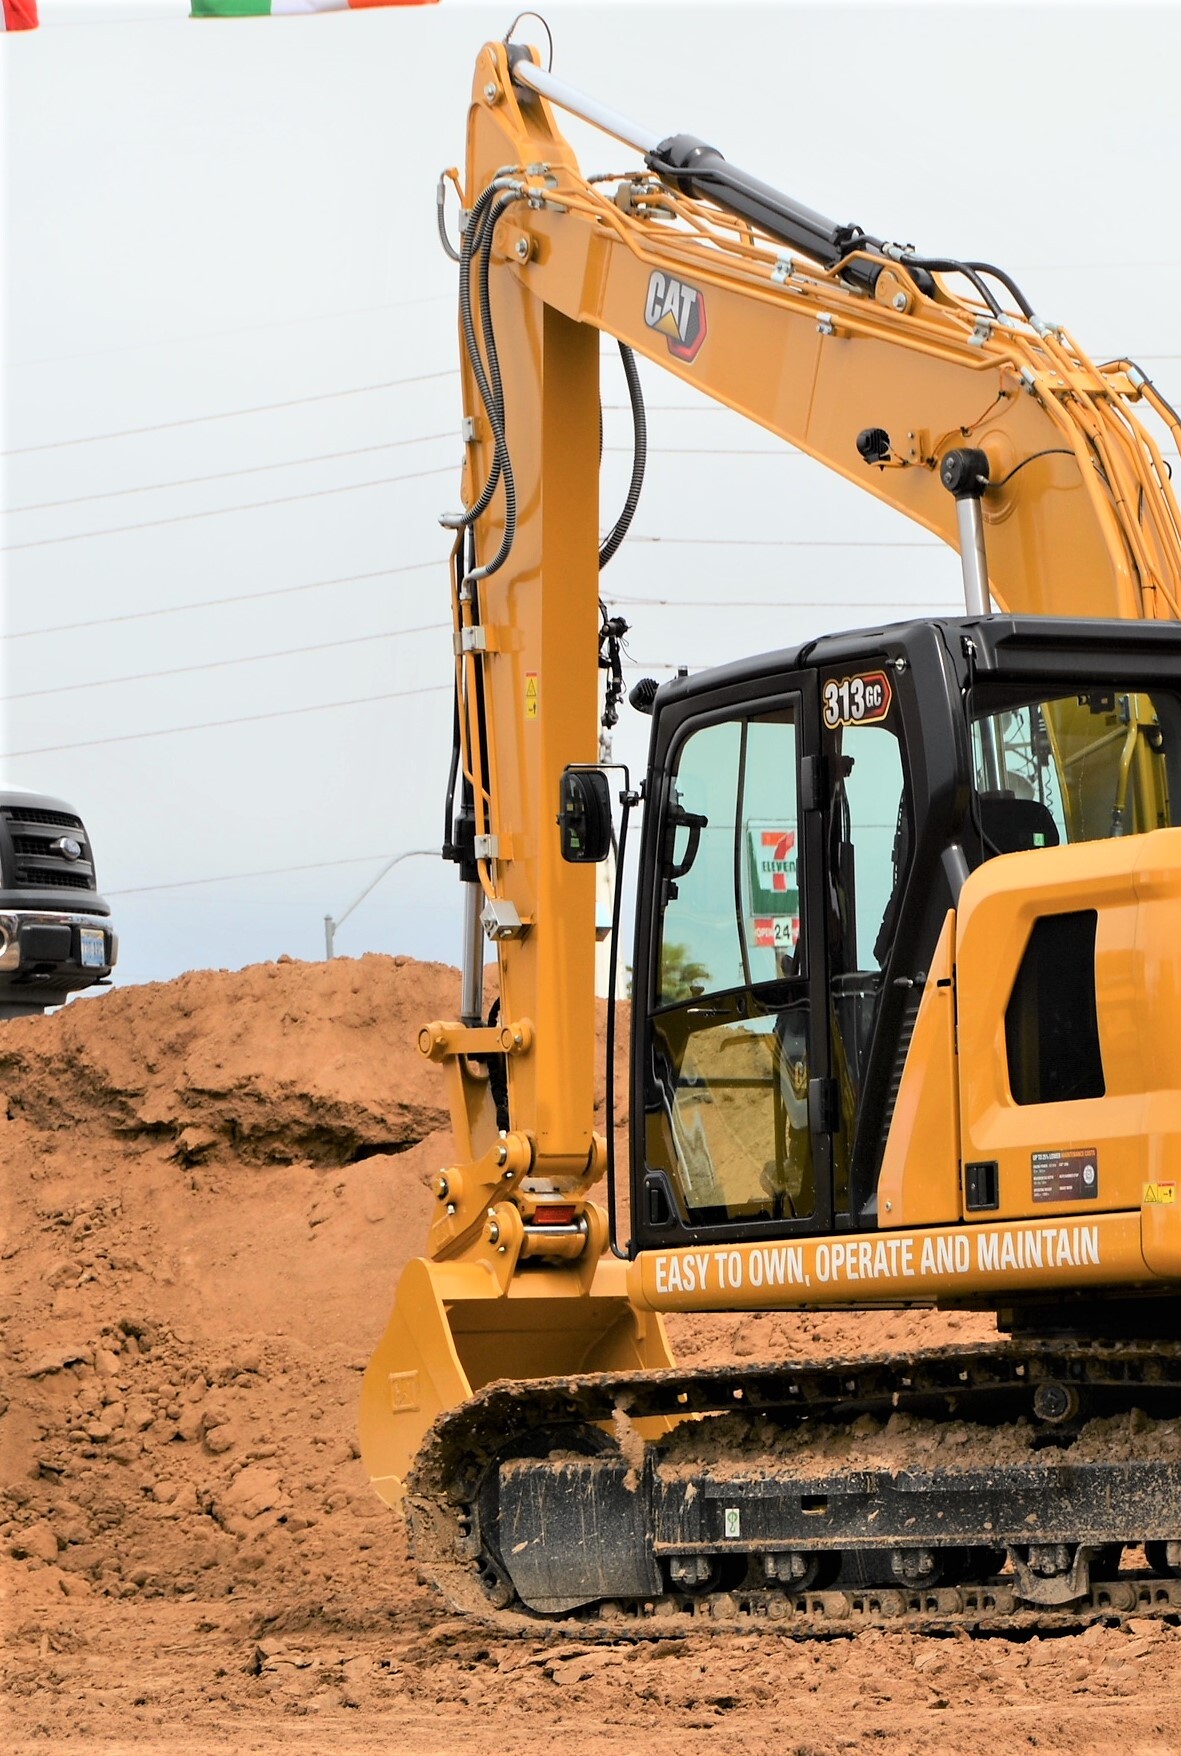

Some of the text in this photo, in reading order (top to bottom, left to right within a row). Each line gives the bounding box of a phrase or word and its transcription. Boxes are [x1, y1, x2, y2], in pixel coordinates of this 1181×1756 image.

[645, 270, 698, 343] CAT
[825, 678, 882, 724] 313 GC
[761, 831, 795, 891] 7
[774, 923, 791, 940] 24
[656, 1226, 1100, 1293] EASY TO OWN, OPERATE AND MAINTAIN
